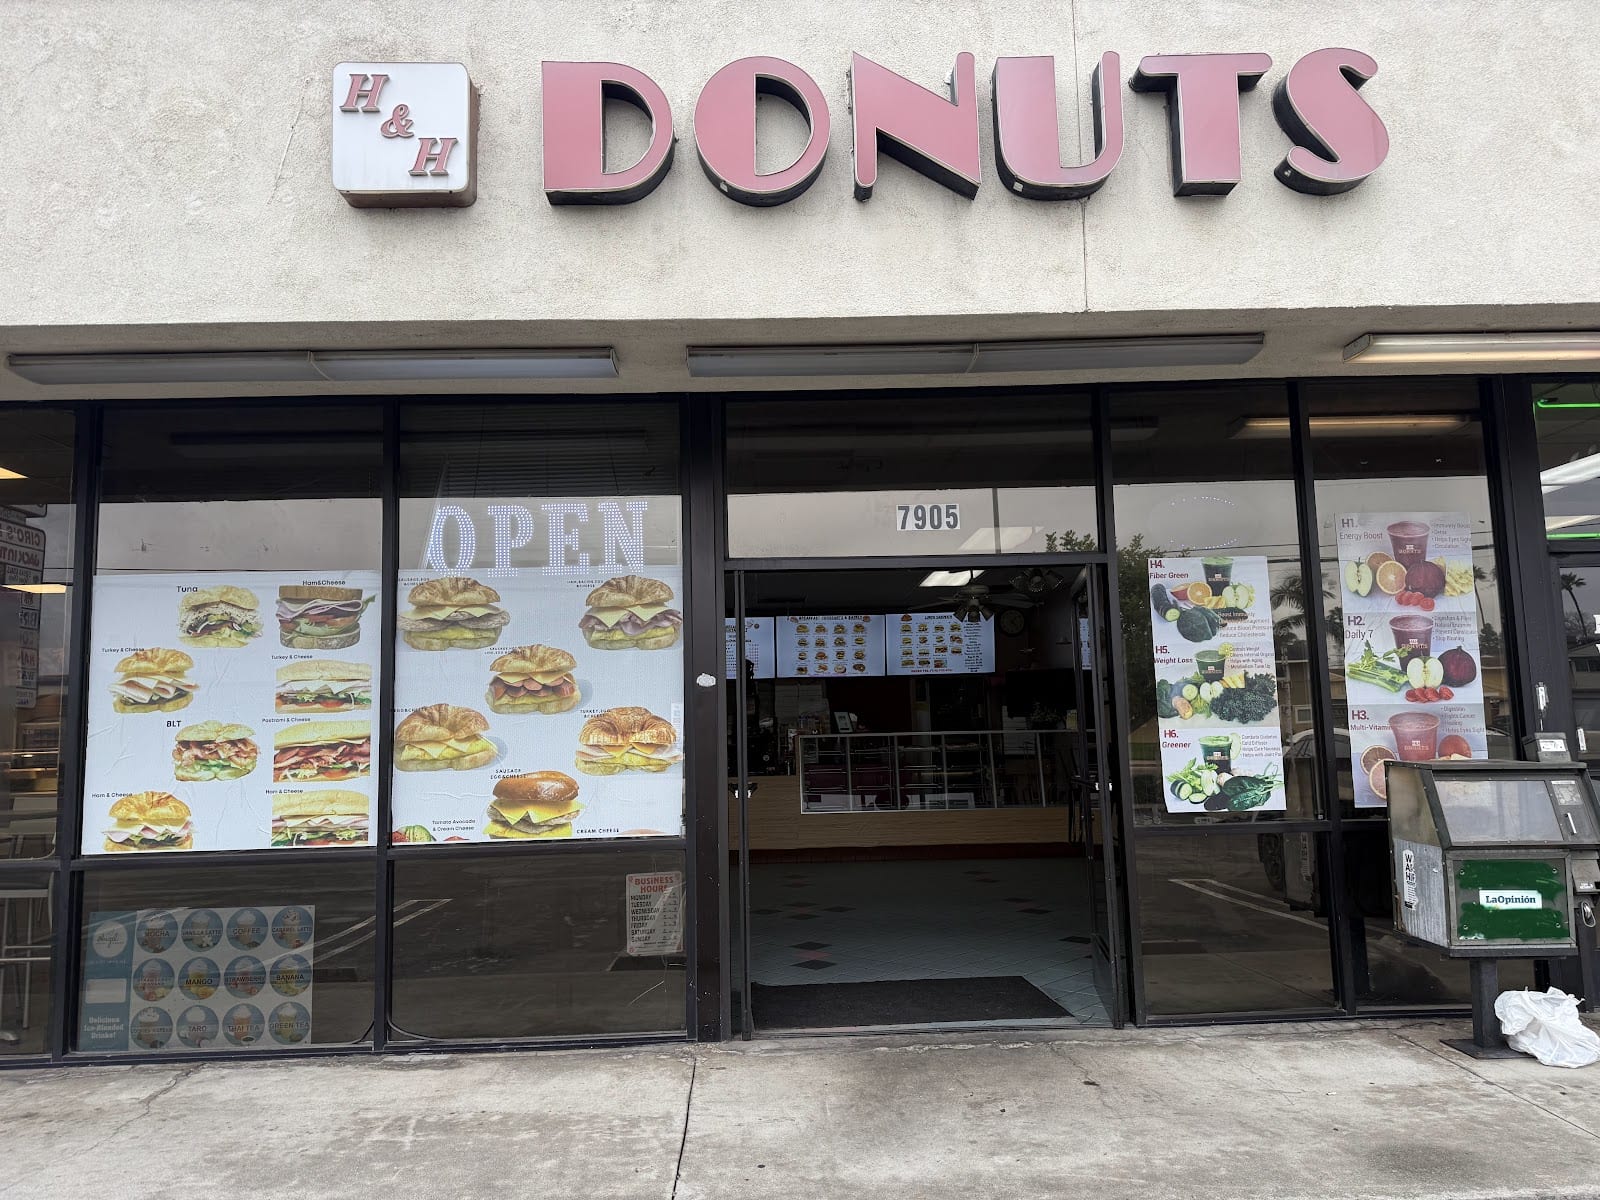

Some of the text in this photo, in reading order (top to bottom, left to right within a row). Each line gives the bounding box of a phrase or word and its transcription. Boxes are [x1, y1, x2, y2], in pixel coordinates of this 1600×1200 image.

[340, 74, 390, 112] H
[380, 103, 415, 138] &
[541, 47, 1390, 206] DONUTS
[408, 138, 459, 176] H
[897, 504, 960, 530] 7905
[1341, 518, 1358, 528] H1.
[425, 500, 649, 578] OPEN
[1340, 532, 1383, 541] Energy Boost
[176, 585, 198, 593] Tuna
[1347, 616, 1365, 626] H2.
[1345, 629, 1374, 639] Daily 7
[1154, 657, 1176, 665] Weight
[1351, 710, 1370, 720] H3.
[166, 720, 182, 728] BLT
[634, 876, 674, 885] BUSINESS
[1486, 895, 1536, 906] LaOpinión
[186, 978, 213, 986] MANGO
